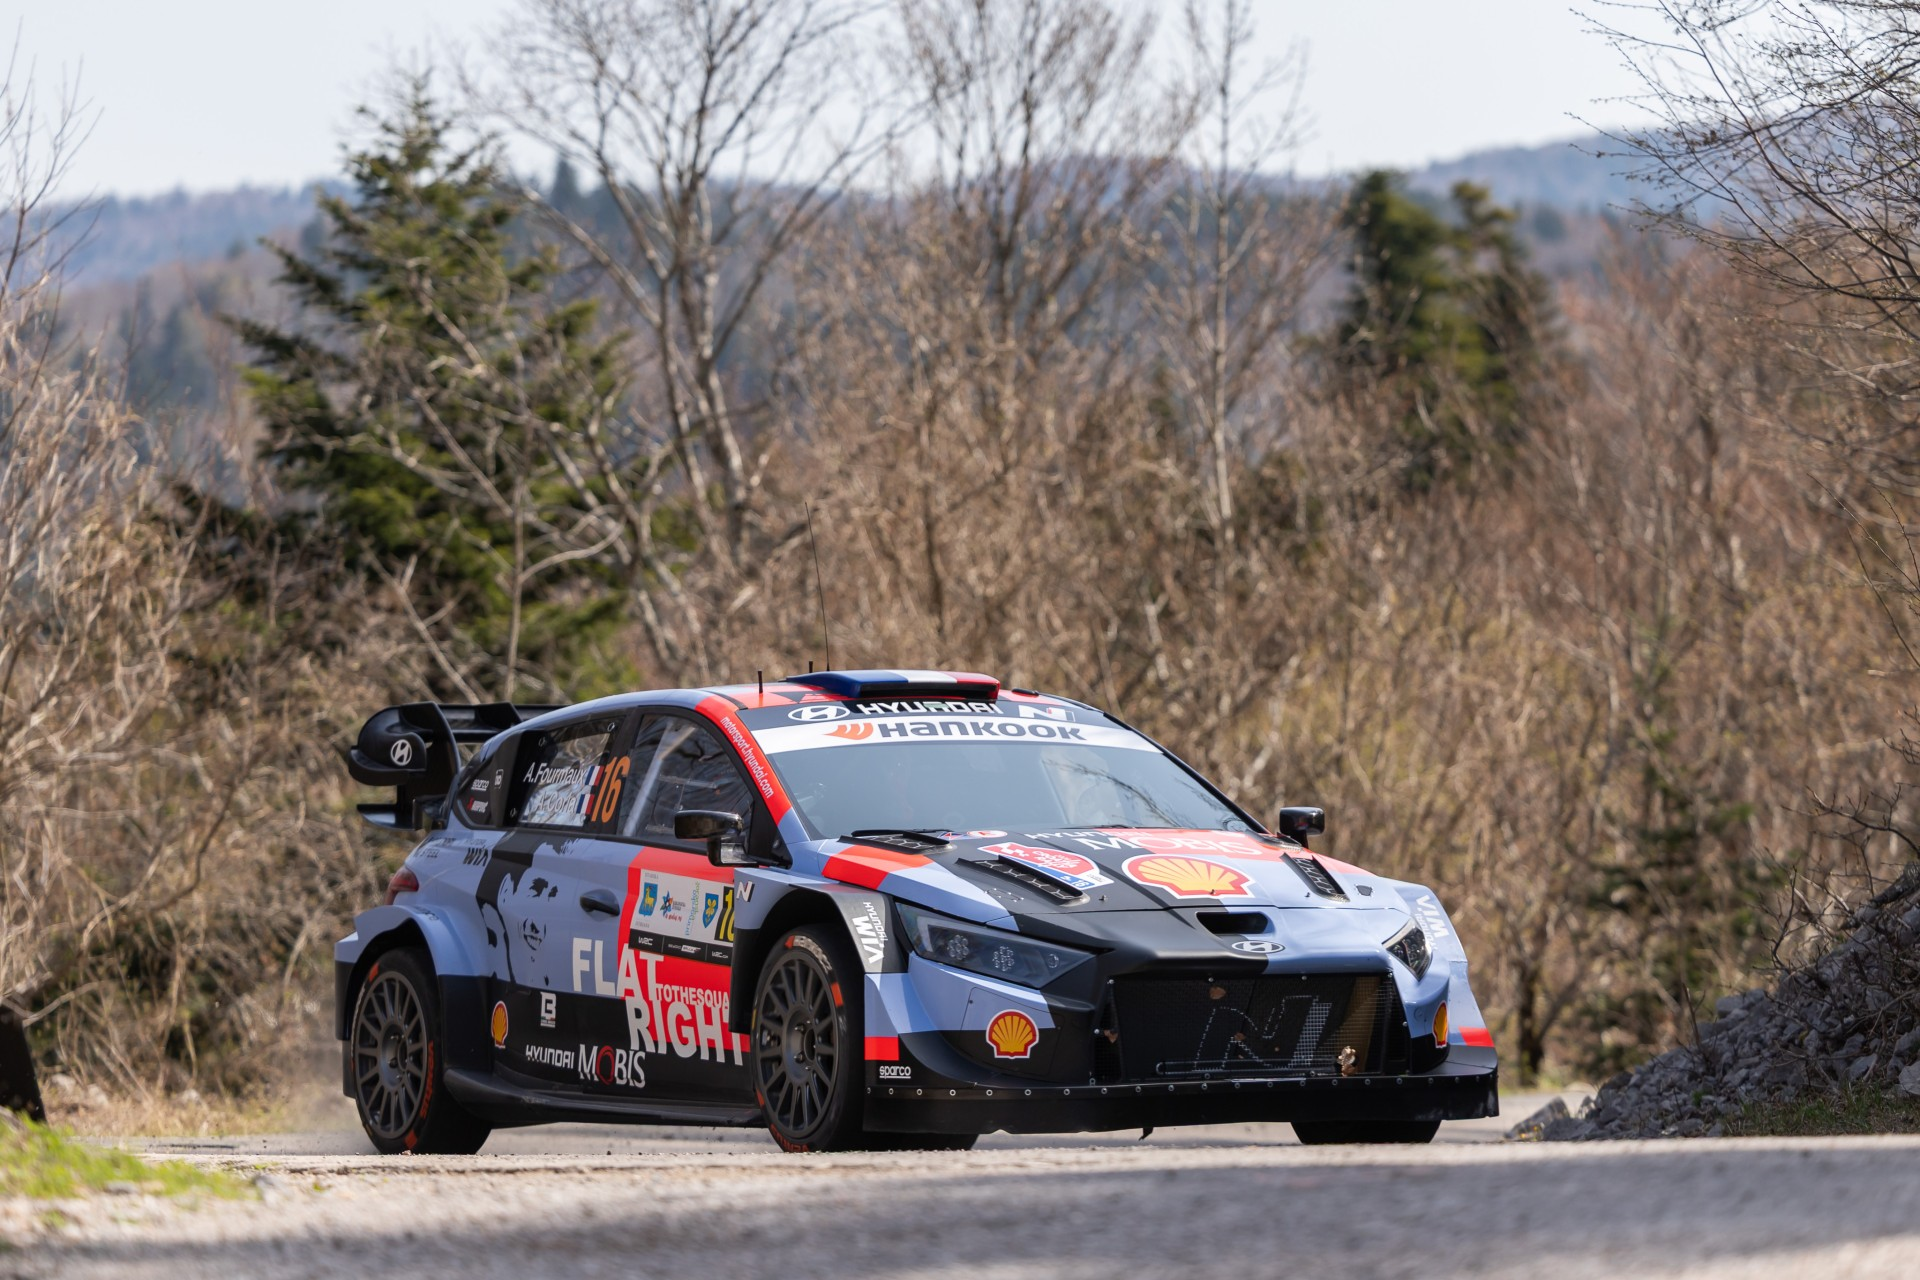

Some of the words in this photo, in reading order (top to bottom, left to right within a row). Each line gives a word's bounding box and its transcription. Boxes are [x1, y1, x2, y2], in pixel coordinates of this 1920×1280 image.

[855, 701, 1004, 715] HYUNDAI
[523, 762, 588, 785] A.Fourmaux
[720, 716, 775, 799] motorsport.hyundai.com
[591, 756, 631, 823] 16
[1072, 836, 1263, 855] MOBIS
[852, 915, 885, 964] WIA
[863, 901, 889, 942] HYUNDAI
[572, 936, 664, 1001] FLAT
[525, 1044, 575, 1069] HYUNDAI
[578, 1043, 647, 1088] MOBIS
[879, 1064, 912, 1079] sparco
